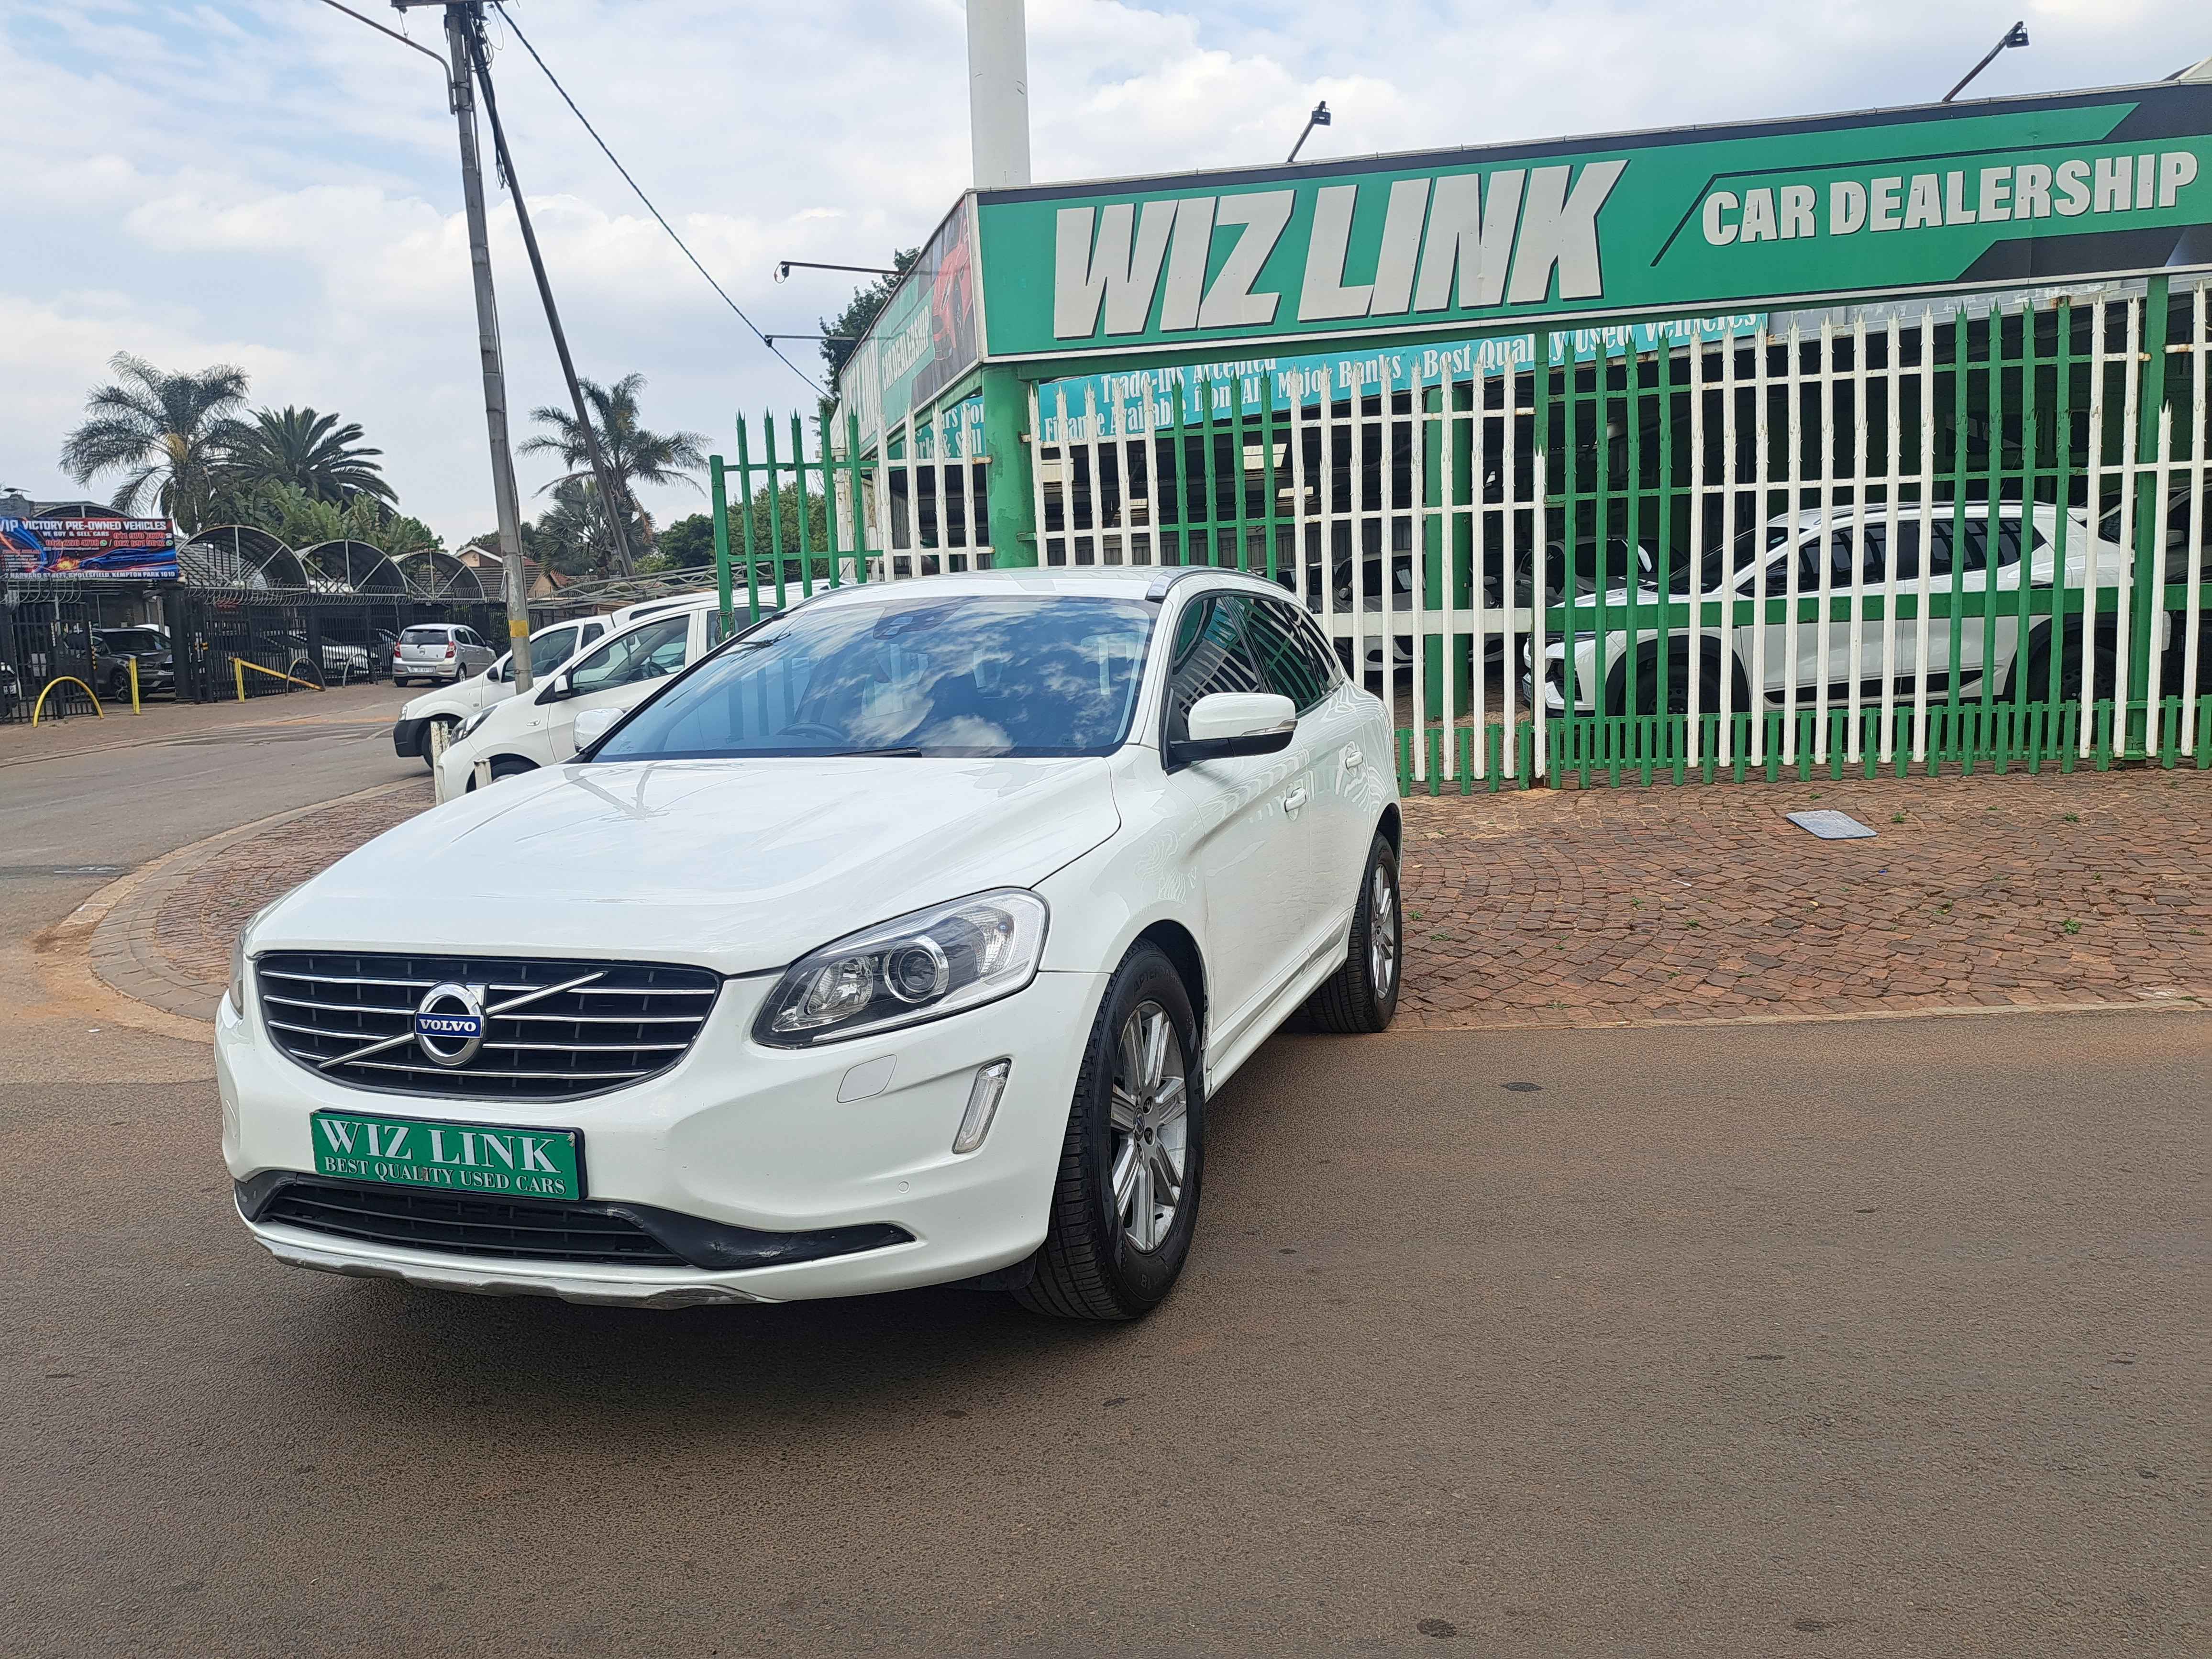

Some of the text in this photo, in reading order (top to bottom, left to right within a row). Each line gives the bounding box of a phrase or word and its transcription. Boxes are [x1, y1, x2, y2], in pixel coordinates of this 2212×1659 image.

[1703, 151, 2198, 246] CAR DEALERSHIP
[1054, 159, 1630, 339] WIZ LINK
[1423, 343, 1471, 378] Best
[1044, 412, 1105, 442] Fiane
[1242, 376, 1261, 404] Al
[955, 428, 982, 457] Sll
[0, 520, 166, 532] VIP VICTORY PRE-OWNED VEHICLES
[419, 1019, 476, 1032] VOLVO
[317, 1118, 562, 1173] WIZ LINK
[324, 1156, 567, 1195] BEST QUALITY USED CARS
